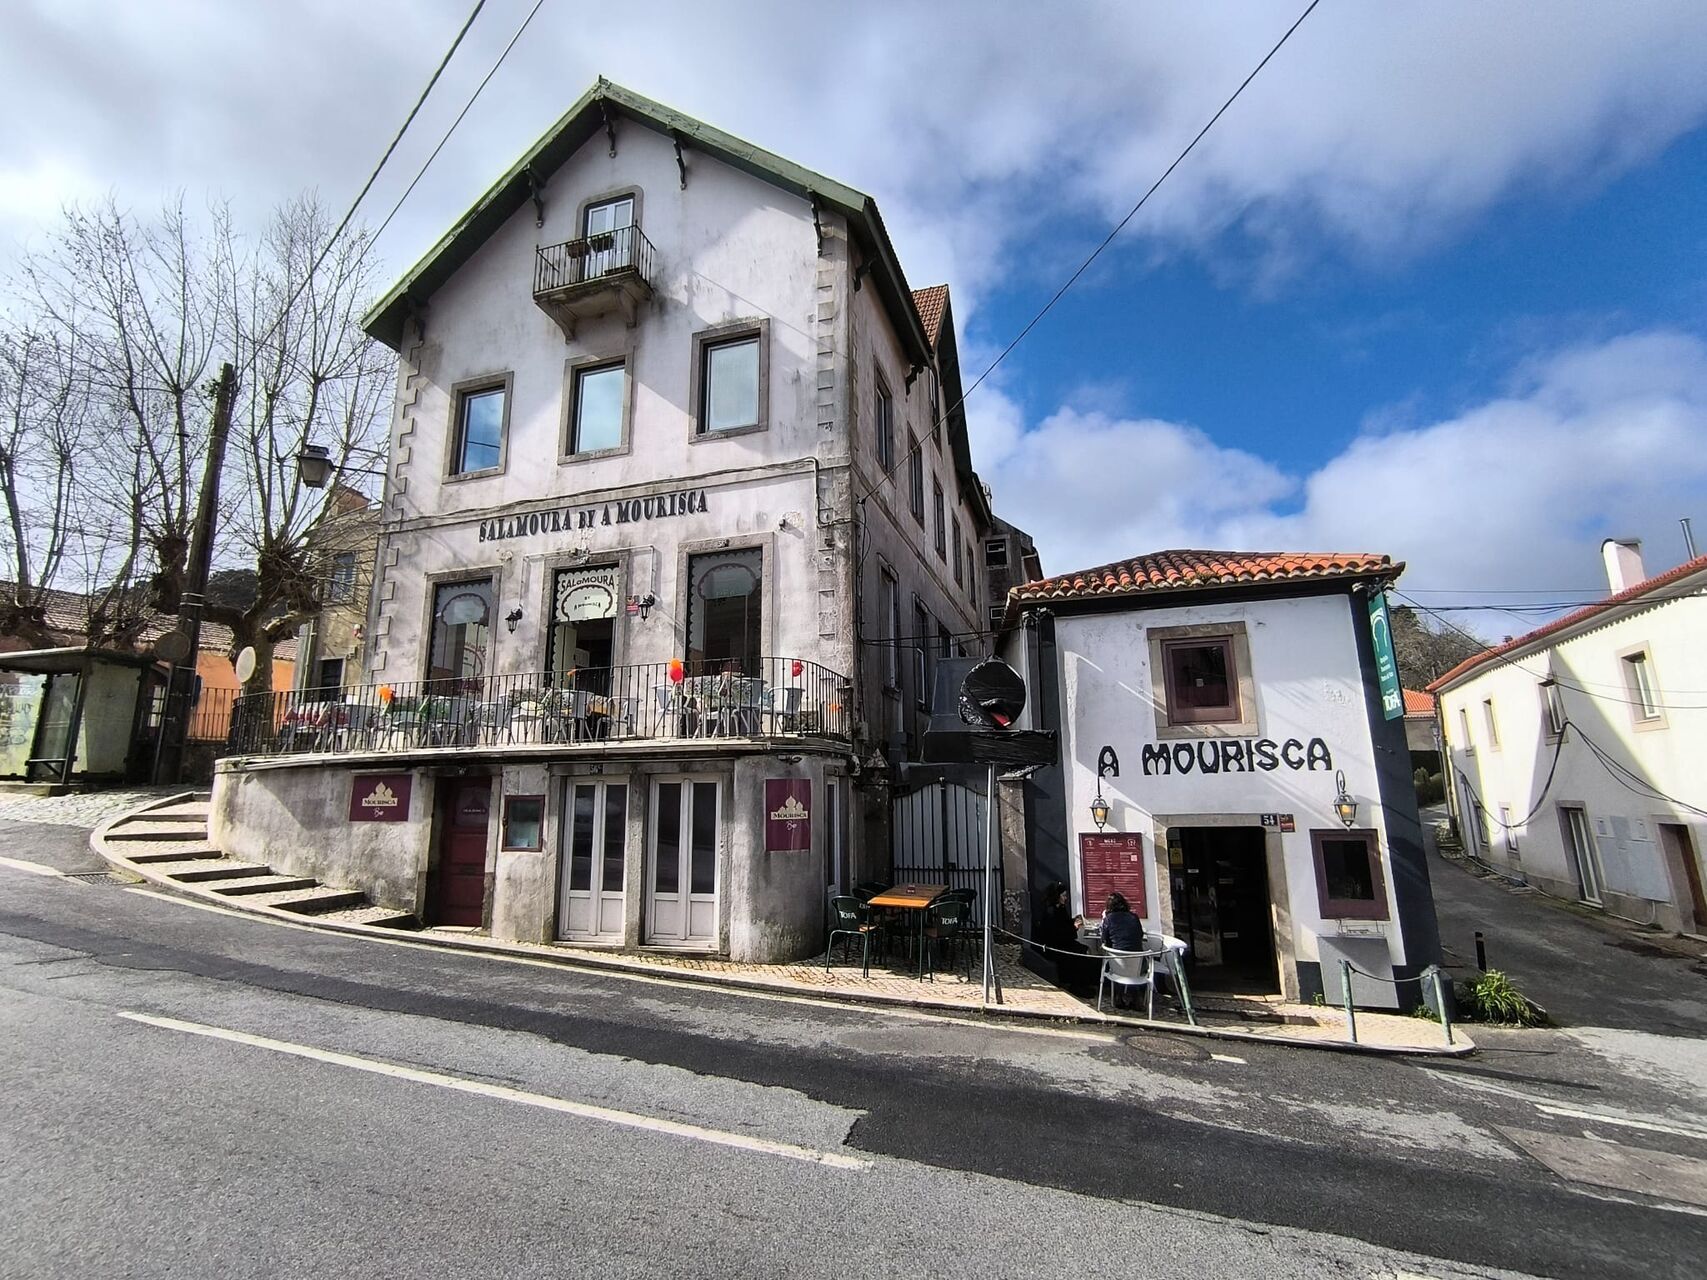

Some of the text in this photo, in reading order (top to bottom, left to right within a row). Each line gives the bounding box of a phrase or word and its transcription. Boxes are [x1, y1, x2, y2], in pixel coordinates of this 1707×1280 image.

[578, 510, 595, 529] BY
[600, 503, 612, 526] A
[615, 490, 708, 524] MOURISCA
[1098, 738, 1333, 777] A MOURISCA
[1263, 815, 1275, 825] 54
[839, 911, 857, 919] TOFA
